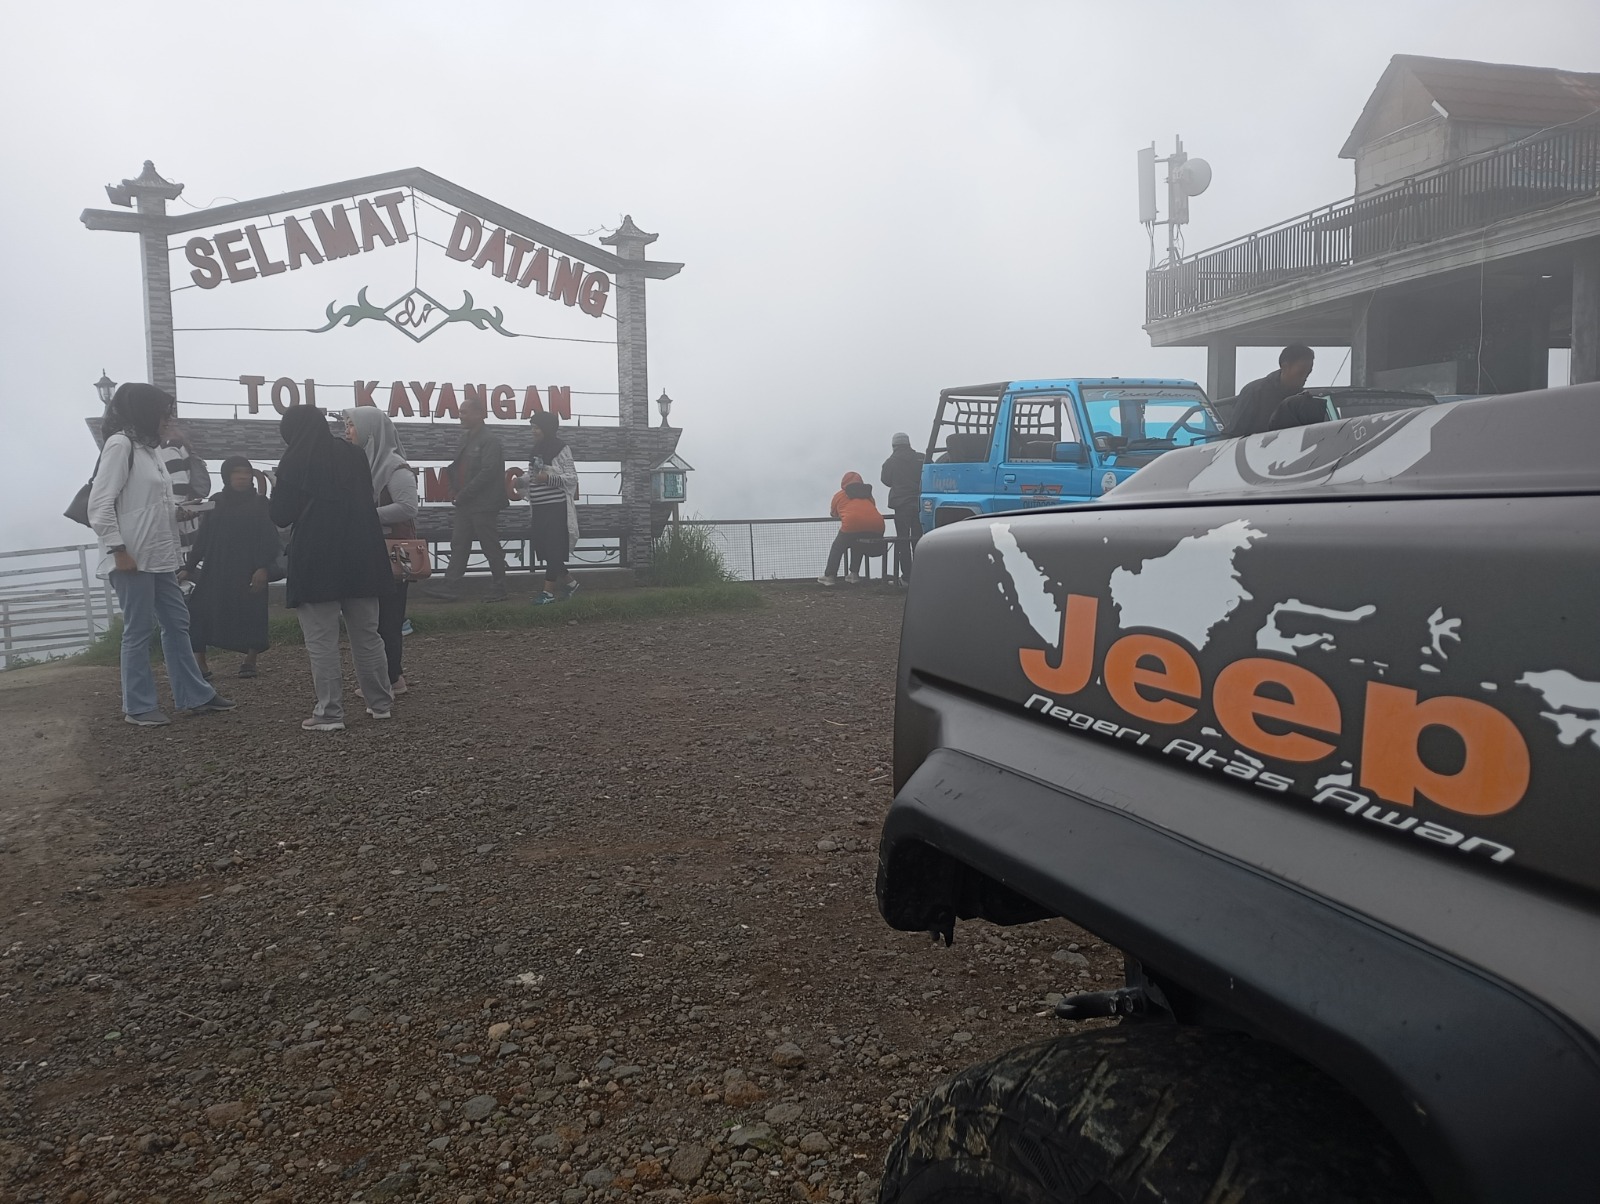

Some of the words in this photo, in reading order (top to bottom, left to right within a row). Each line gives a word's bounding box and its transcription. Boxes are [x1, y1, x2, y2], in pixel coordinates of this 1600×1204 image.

[185, 192, 409, 289] SELAMAT
[445, 211, 610, 318] DATANG
[354, 380, 571, 420] KAYANGAN
[1019, 593, 1530, 815] Jeep
[1162, 738, 1295, 792] Atas
[1312, 787, 1515, 863] Awan
